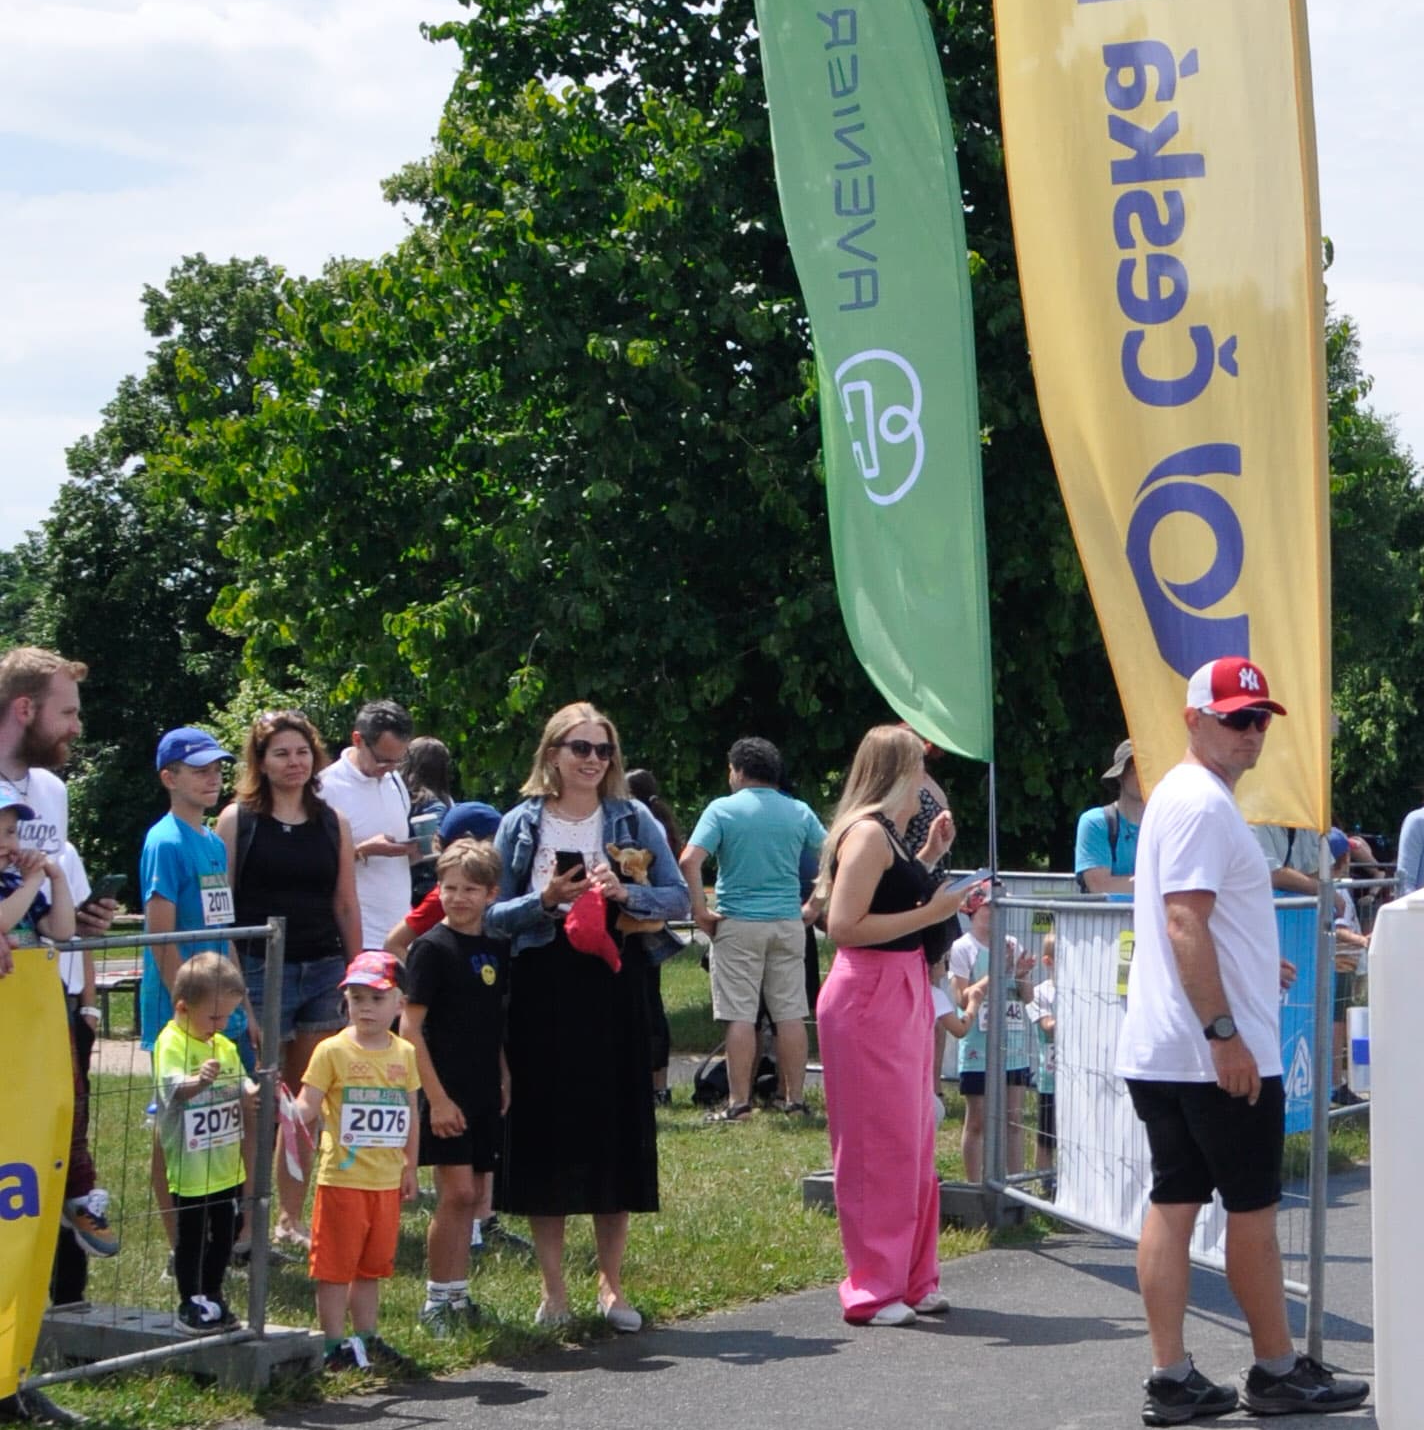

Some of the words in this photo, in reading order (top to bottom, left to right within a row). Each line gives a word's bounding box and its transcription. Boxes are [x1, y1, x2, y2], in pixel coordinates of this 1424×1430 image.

[207, 890, 230, 913] 2011
[192, 1103, 241, 1137] 2079
[350, 1108, 406, 1133] 2076
